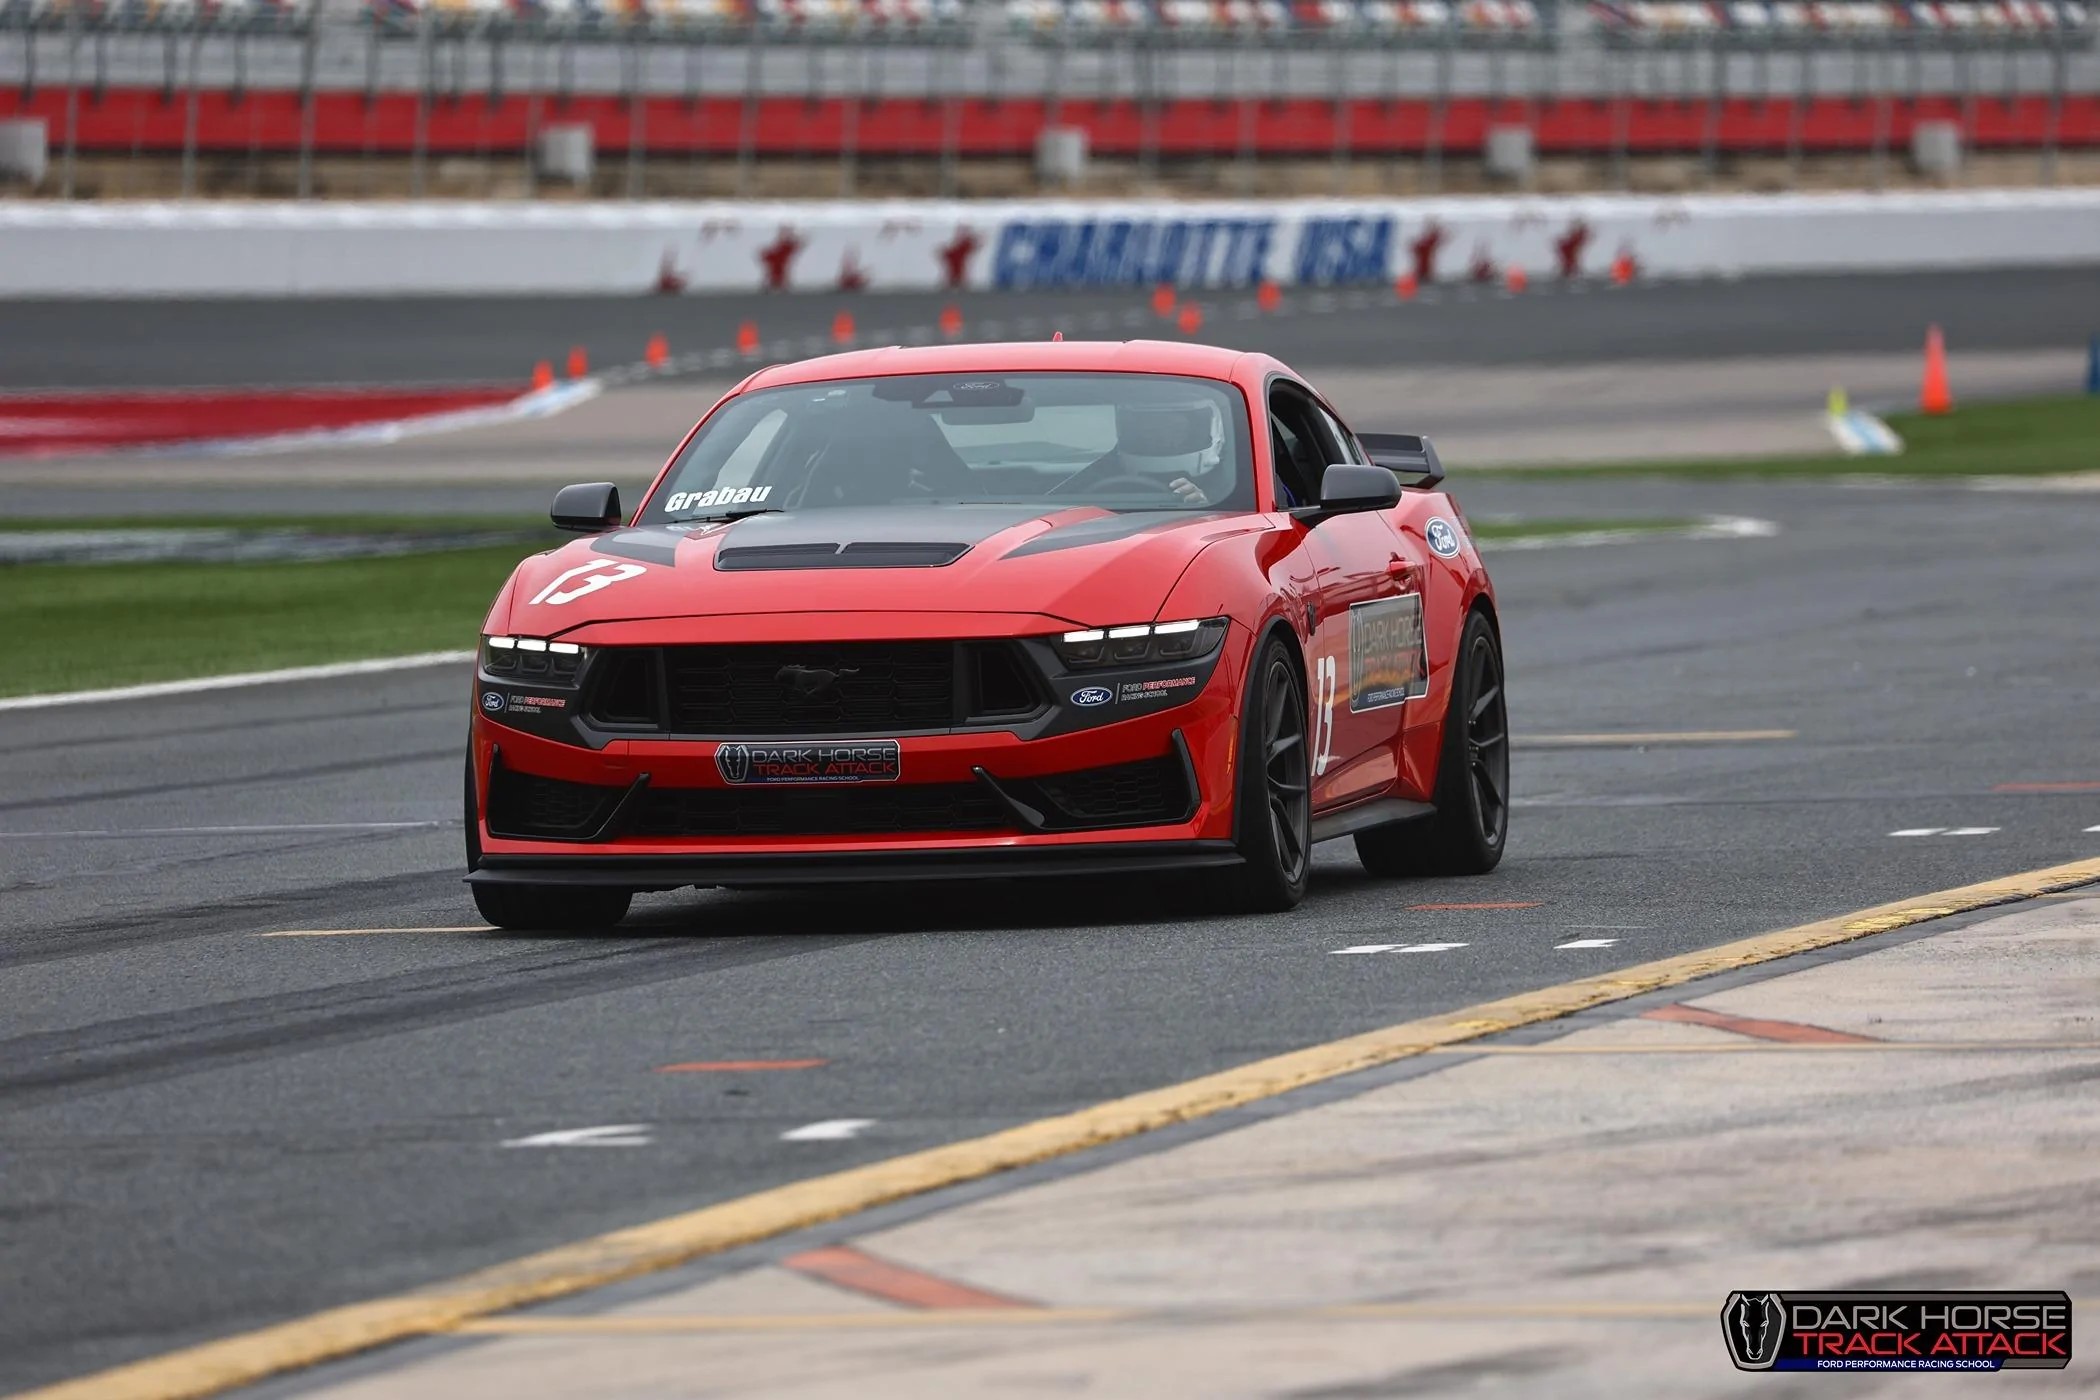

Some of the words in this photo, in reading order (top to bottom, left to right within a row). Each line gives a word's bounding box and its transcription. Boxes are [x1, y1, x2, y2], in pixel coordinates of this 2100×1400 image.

[994, 217, 1278, 287] CHARLOTTE
[1296, 215, 1395, 283] USA
[664, 486, 772, 512] Grabau
[1431, 524, 1456, 551] Ford
[528, 558, 647, 604] 13
[1122, 683, 1142, 693] FORD
[1142, 677, 1196, 691] PERFORMANCE
[485, 694, 500, 708] Ford
[1079, 690, 1104, 703] Ford
[1311, 655, 1335, 776] 13
[752, 749, 812, 763] DARK
[818, 748, 896, 762] HORSE
[753, 763, 819, 776] TRACK
[824, 762, 896, 775] ATTACK
